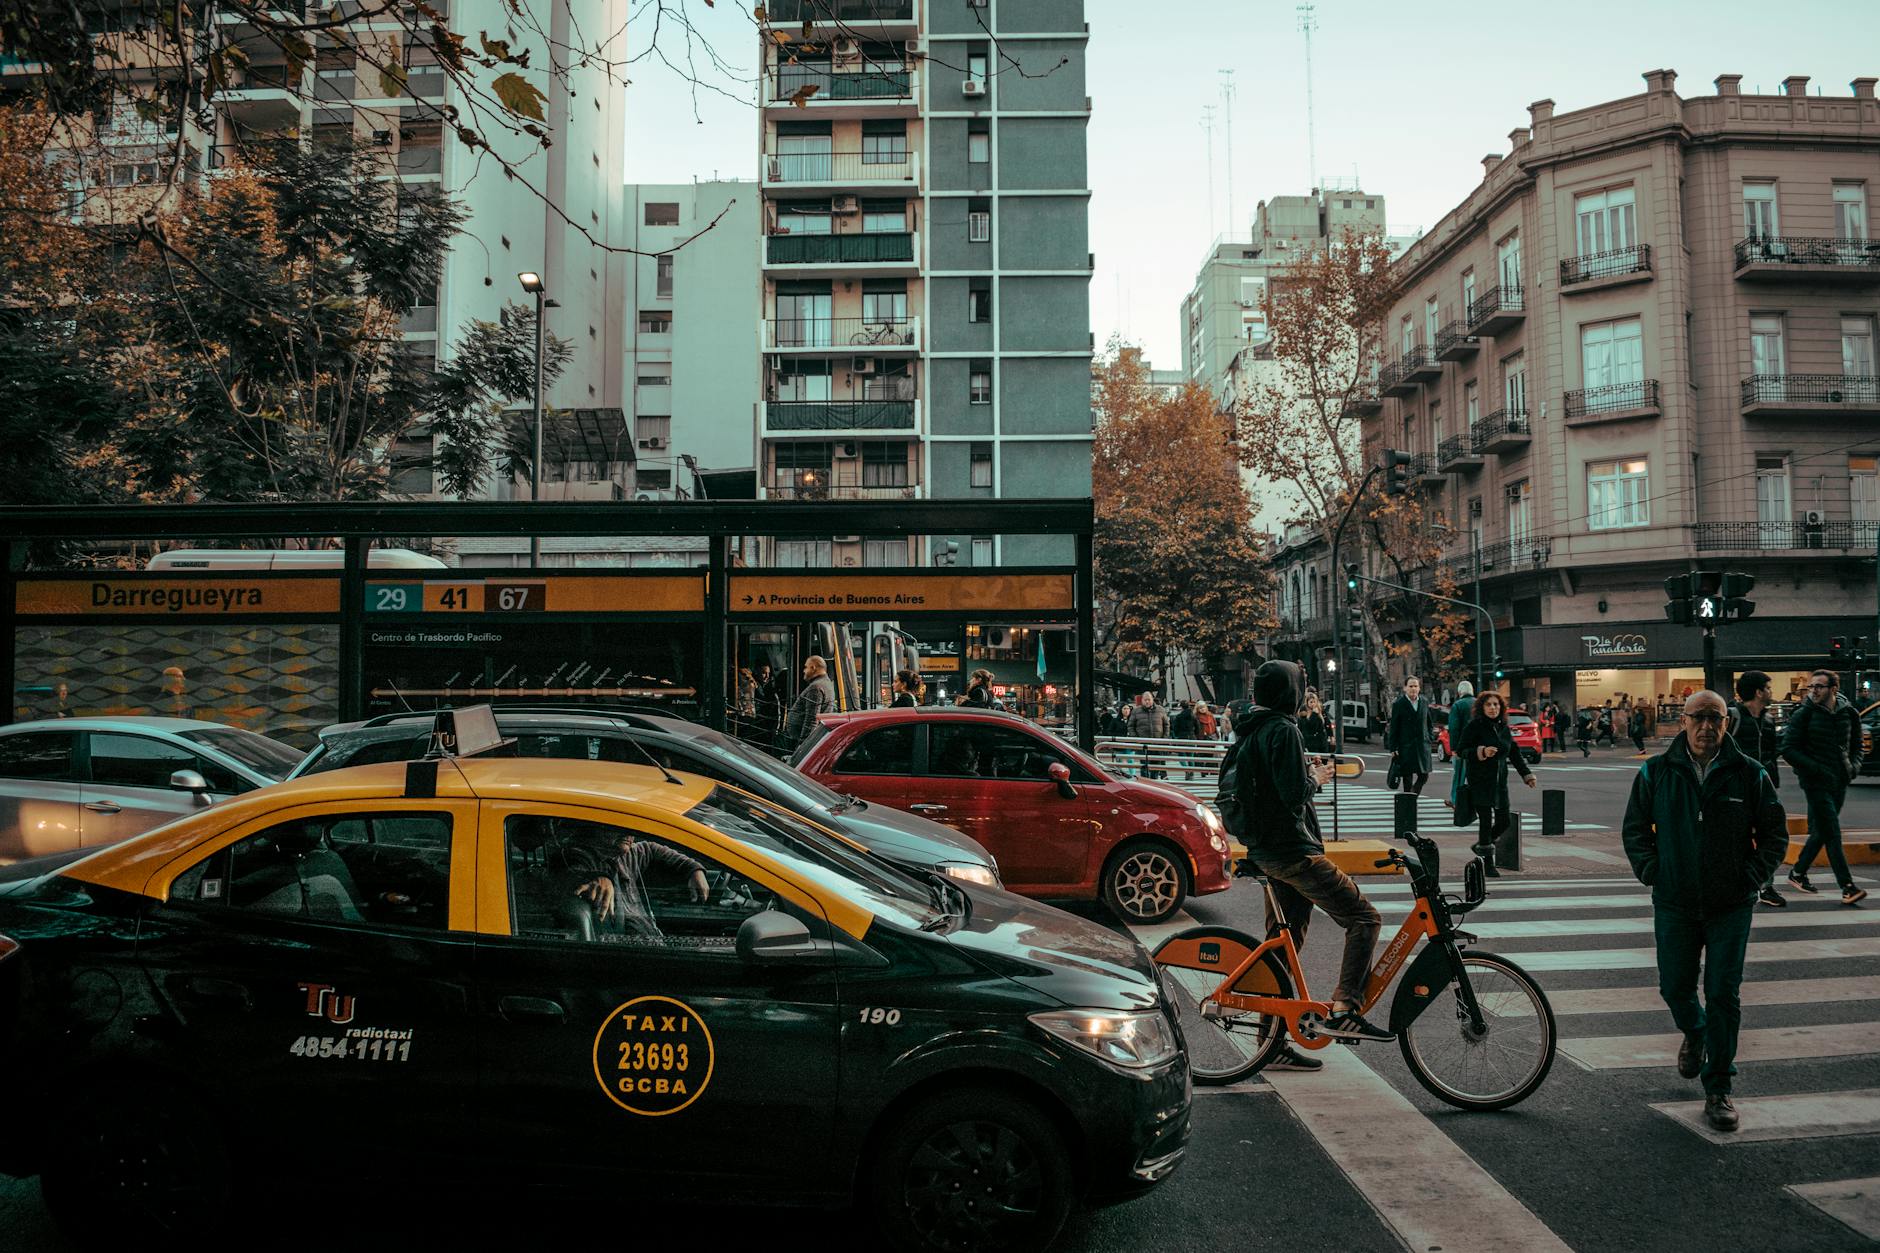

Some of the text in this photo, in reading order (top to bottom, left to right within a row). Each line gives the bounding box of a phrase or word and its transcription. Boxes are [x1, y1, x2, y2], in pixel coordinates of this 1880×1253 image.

[92, 583, 262, 611] Darregueyra
[376, 587, 529, 610] 29 41 67
[758, 594, 925, 605] A Provincia de Buenos Aires
[371, 633, 401, 642] Centro
[404, 633, 416, 642] de
[418, 633, 464, 642] Trasbordo
[1581, 635, 1647, 656] Panadería
[1598, 636, 1611, 646] La
[1384, 930, 1410, 965] Ecobici
[298, 982, 356, 1024] TU
[622, 1015, 688, 1032] TAXI
[860, 1007, 901, 1025] 190
[346, 1027, 413, 1040] radiotaxi
[618, 1042, 689, 1071] 23693
[619, 1077, 687, 1094] GCBA
